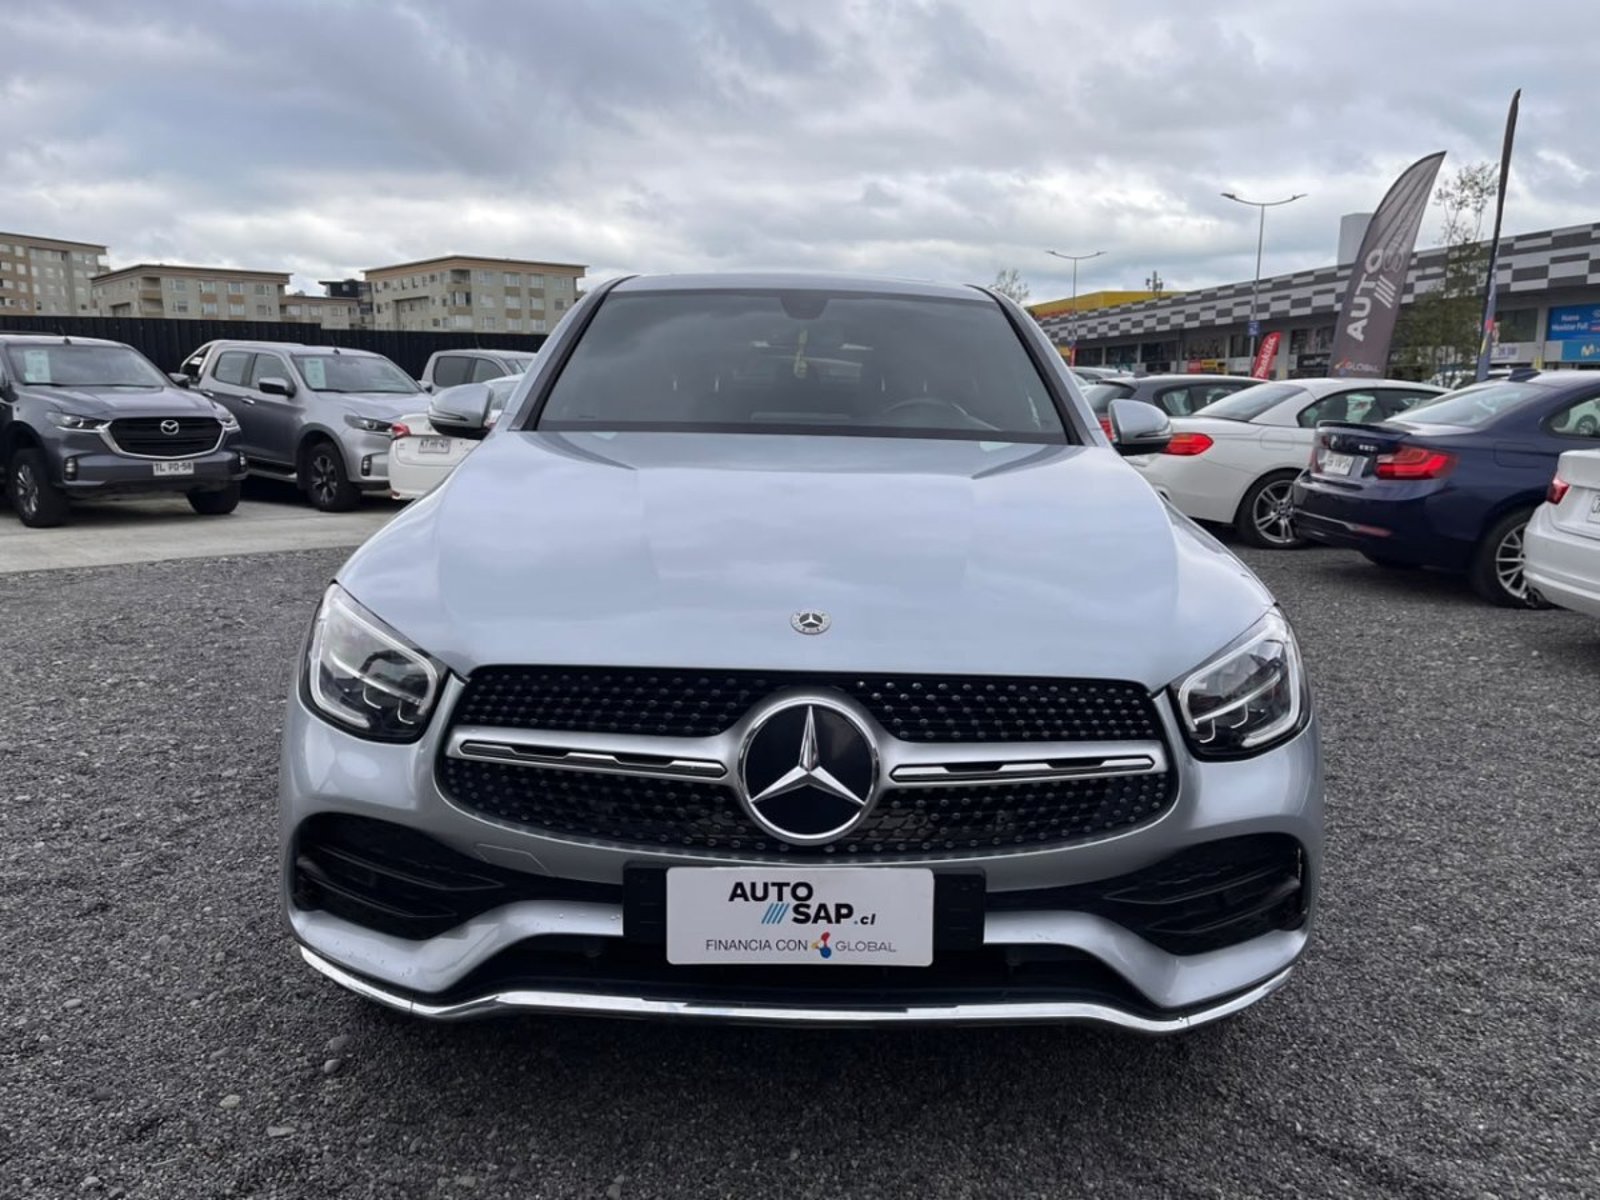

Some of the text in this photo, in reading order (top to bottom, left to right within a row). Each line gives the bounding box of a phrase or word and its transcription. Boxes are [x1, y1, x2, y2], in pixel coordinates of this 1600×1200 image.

[1346, 248, 1384, 342] AUTO
[728, 881, 814, 902] AUTO
[705, 939, 896, 953] FINANCIA CON GLOBAL
